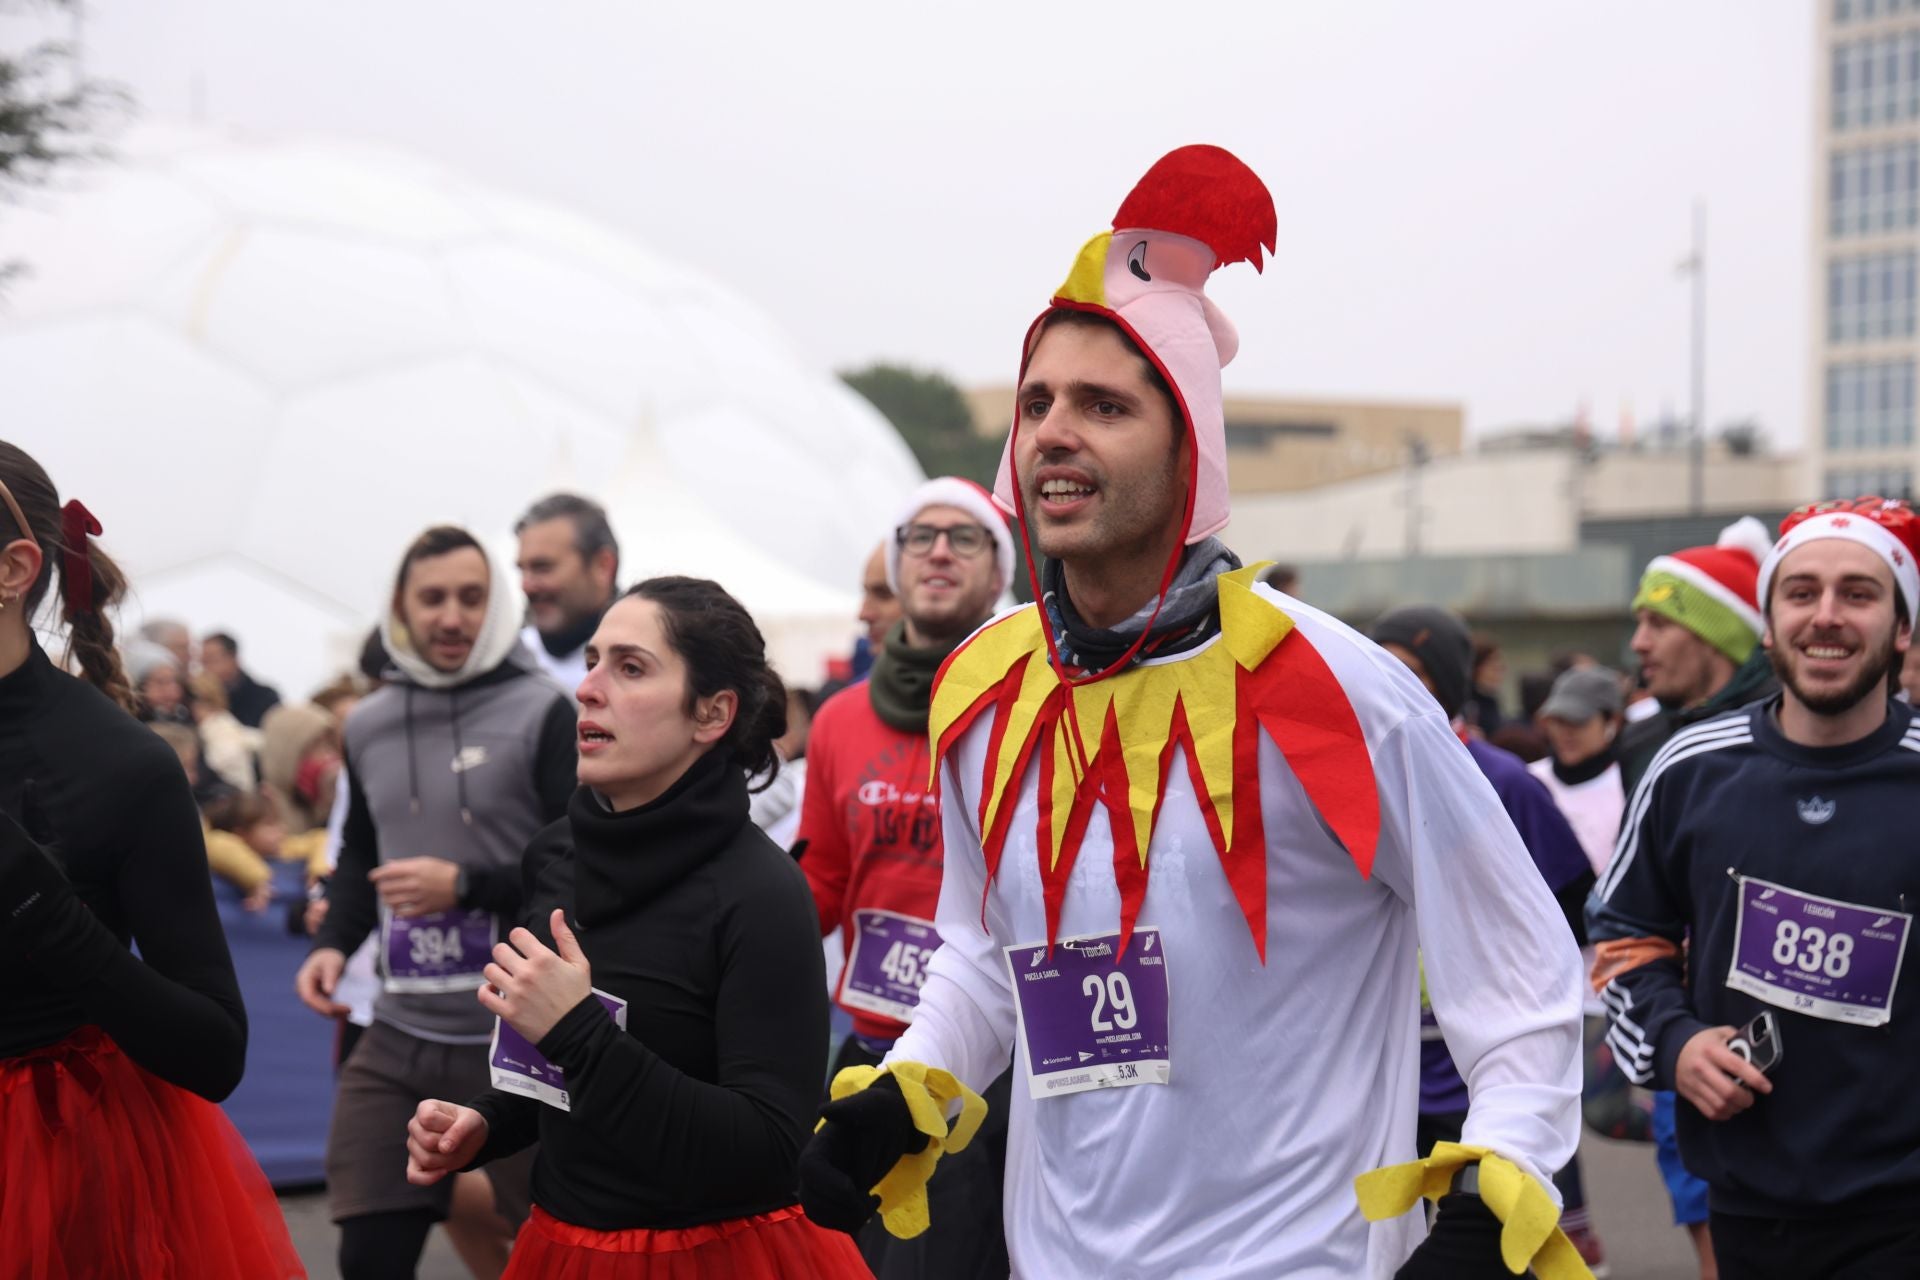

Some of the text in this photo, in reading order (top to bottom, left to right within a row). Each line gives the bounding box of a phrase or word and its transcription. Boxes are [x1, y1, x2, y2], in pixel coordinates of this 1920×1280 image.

[408, 925, 464, 965] 394
[1772, 919, 1855, 979] 838
[1082, 971, 1137, 1033] 29
[1118, 1063, 1139, 1080] 5,3K
